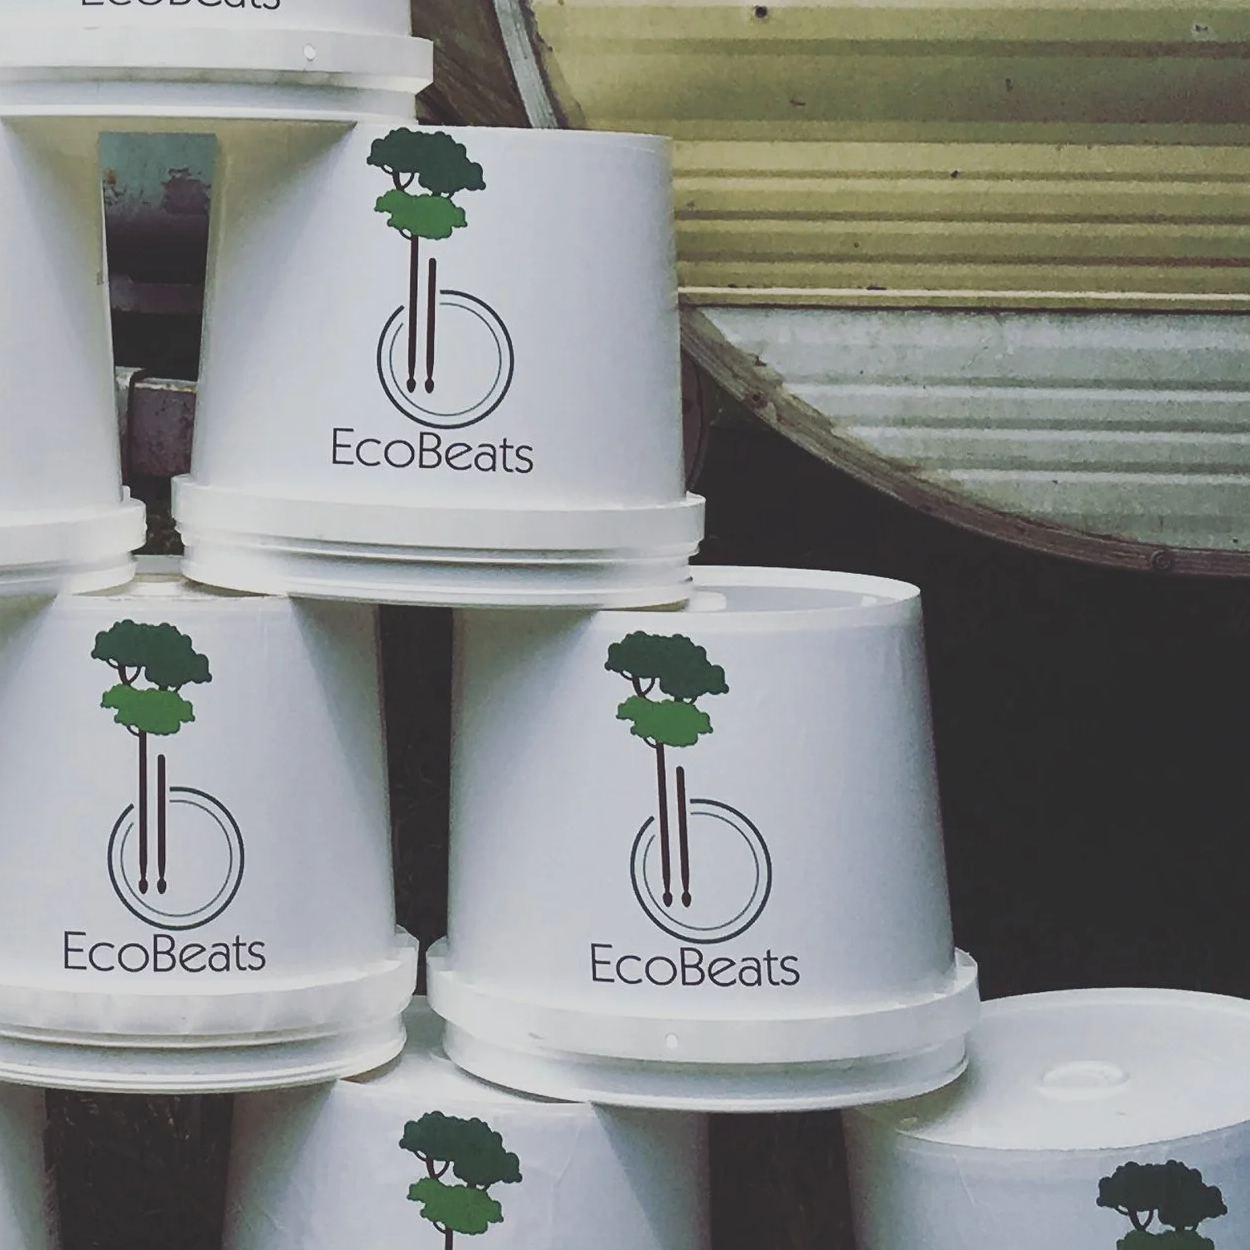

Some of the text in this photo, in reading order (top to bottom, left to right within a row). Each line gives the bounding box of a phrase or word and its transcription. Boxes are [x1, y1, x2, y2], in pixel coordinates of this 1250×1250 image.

[333, 428, 533, 473] EcoBeats
[65, 932, 265, 972] EcoBeats
[591, 943, 799, 987] EcoBeats
